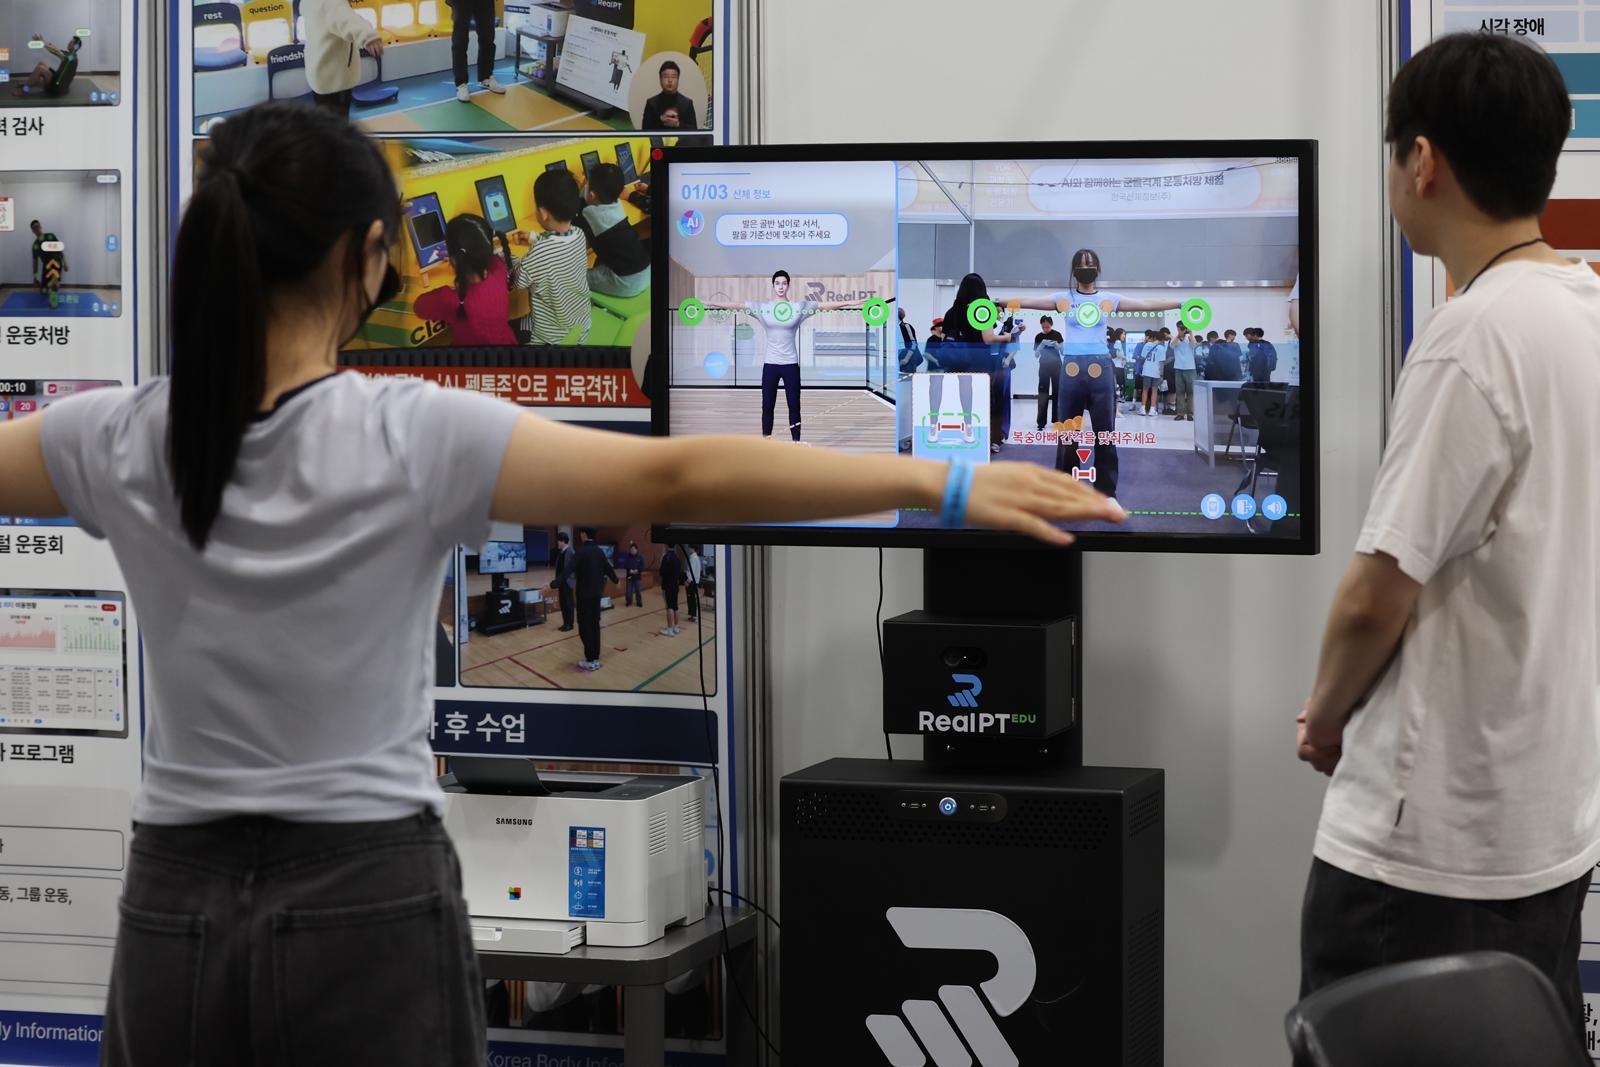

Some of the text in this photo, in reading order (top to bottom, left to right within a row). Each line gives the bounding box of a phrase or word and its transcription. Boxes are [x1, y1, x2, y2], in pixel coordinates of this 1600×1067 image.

[203, 12, 223, 20] rest
[249, 4, 284, 14] question
[1479, 18, 1544, 36] 시각 장애
[12, 116, 45, 136] 검사
[681, 184, 771, 200] 01/03 신체 정보
[687, 218, 699, 228] AI
[808, 231, 831, 240] 주세요
[6, 326, 71, 345] 운동처방
[554, 374, 619, 403] 교육격차
[15, 534, 63, 555] 운동회
[444, 711, 470, 741] 후
[475, 713, 525, 743] 수업
[919, 710, 1036, 734] RealPT EDU
[10, 744, 74, 764] 프로그램
[495, 817, 533, 826] SAMSUNG
[16, 887, 41, 902] 그룹
[44, 887, 72, 906] 운동,
[0, 1022, 12, 1041] y
